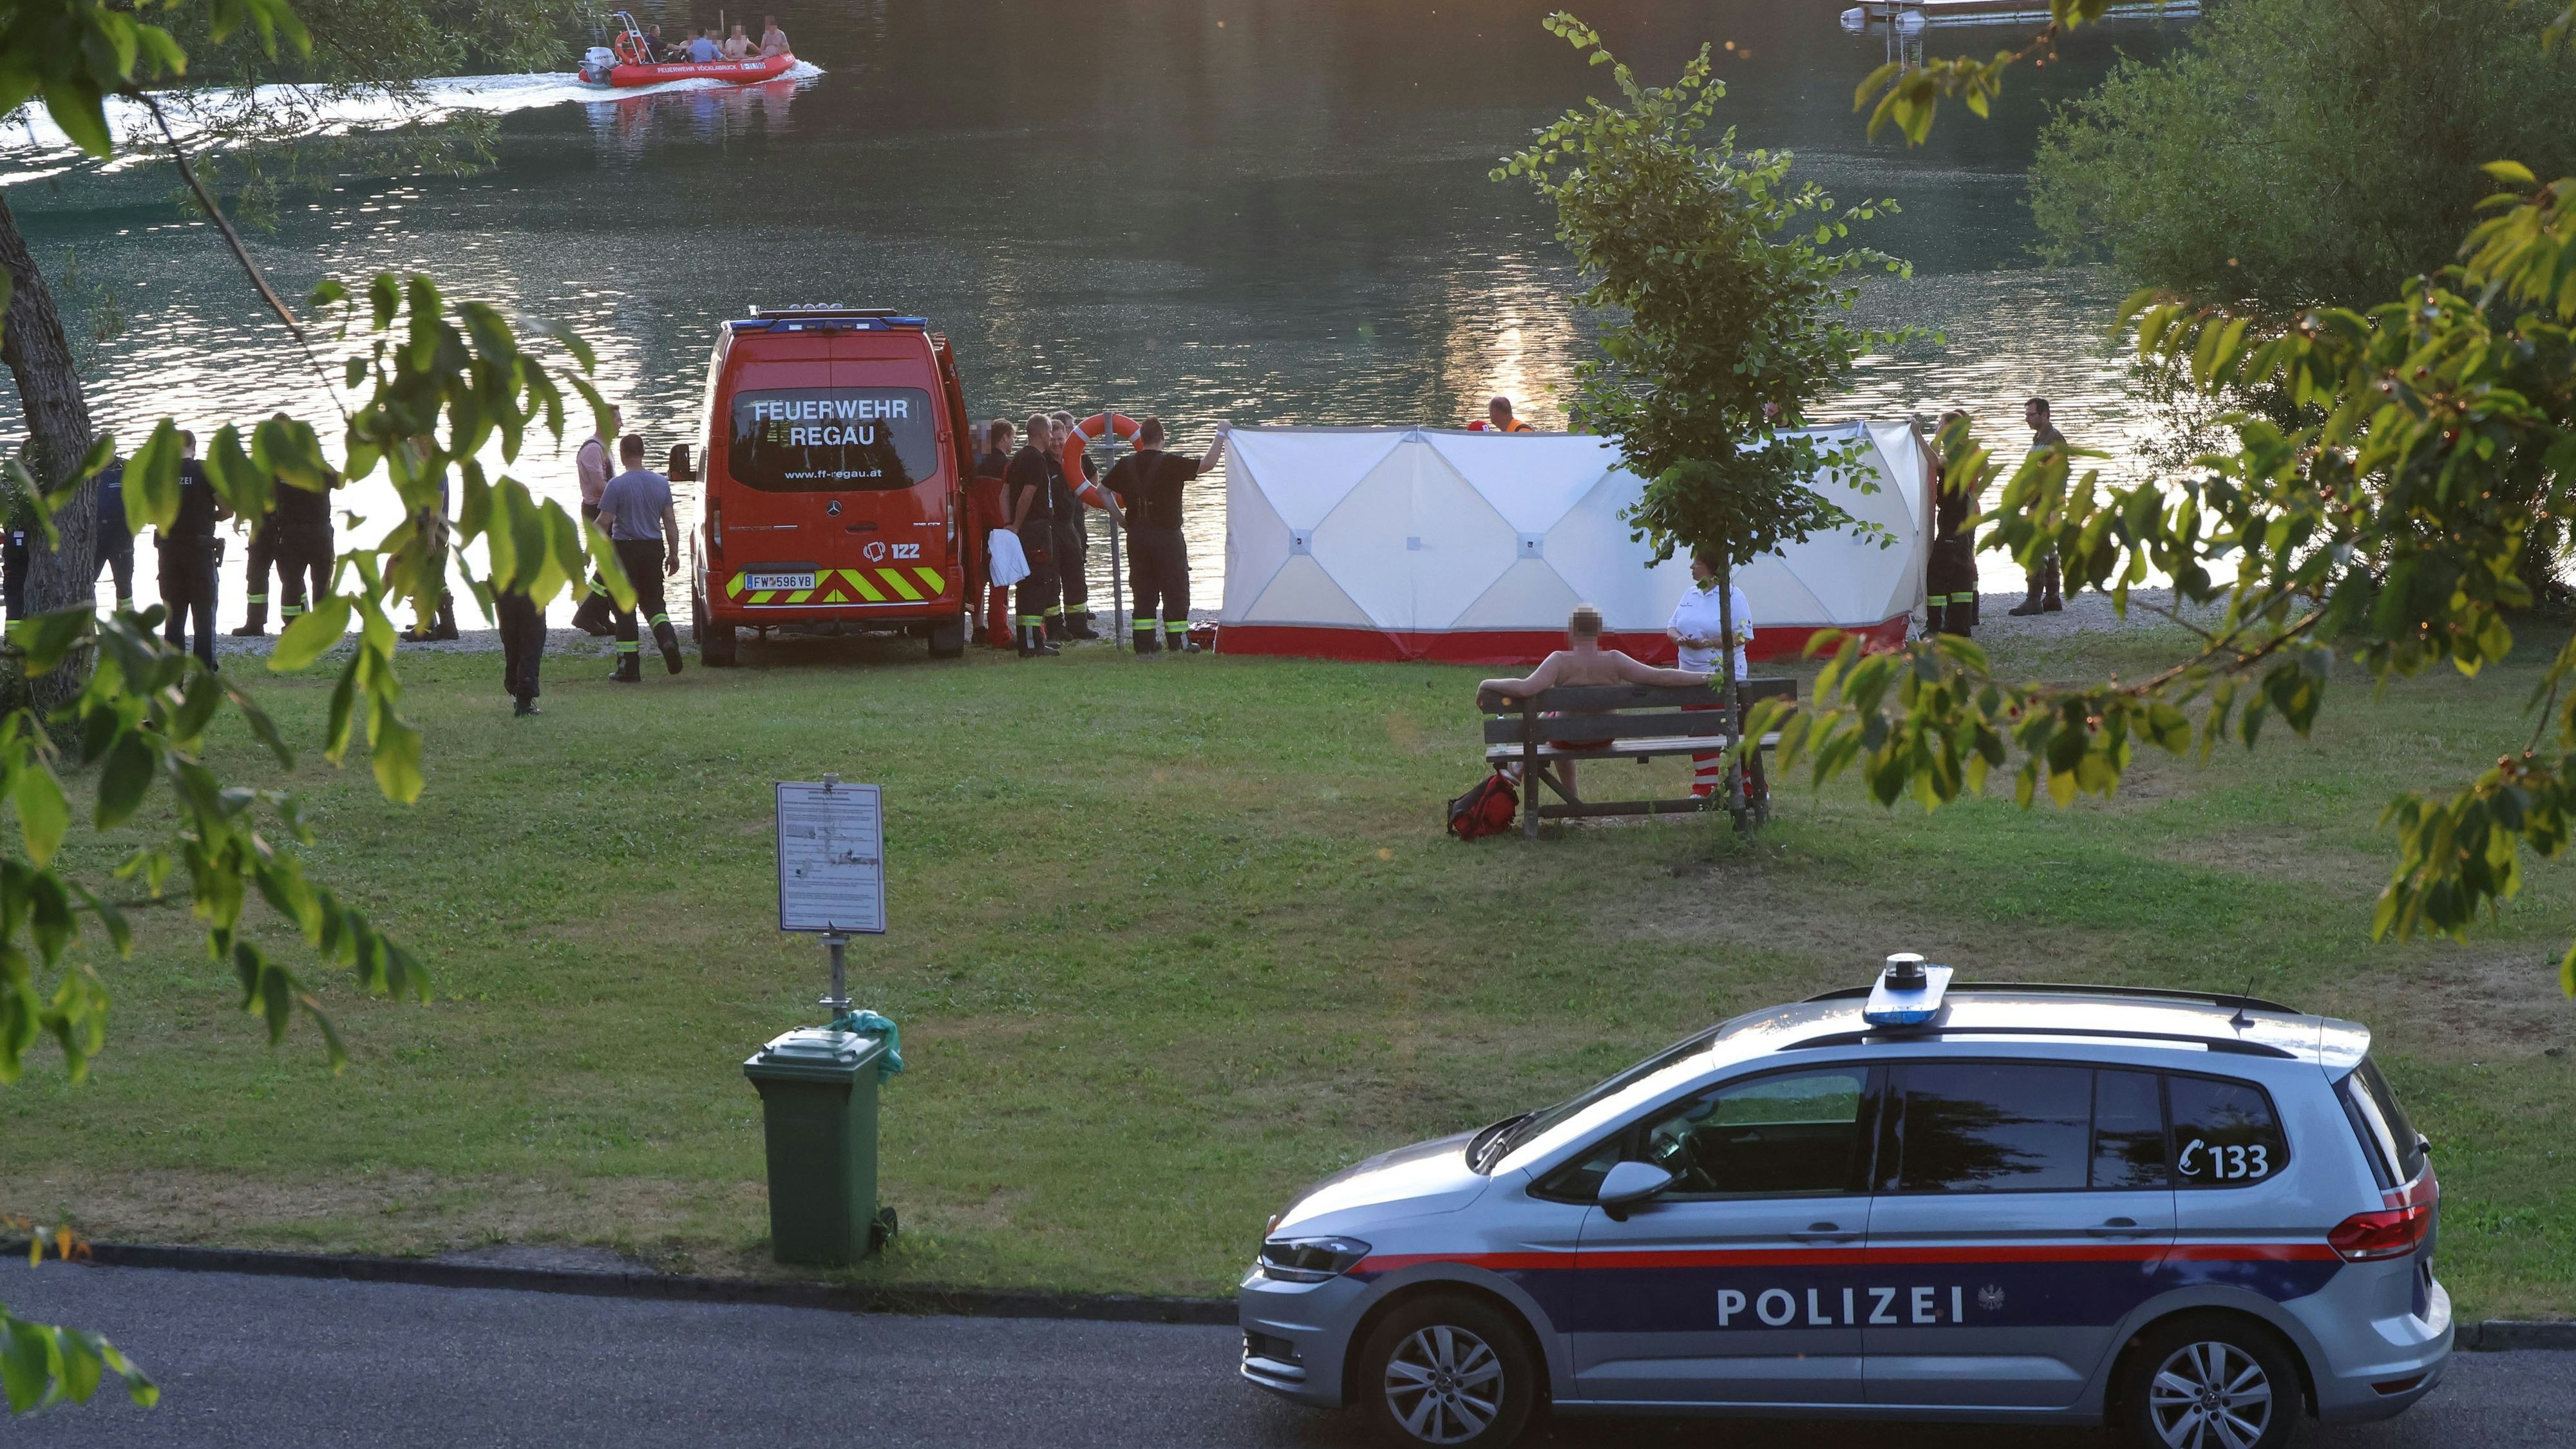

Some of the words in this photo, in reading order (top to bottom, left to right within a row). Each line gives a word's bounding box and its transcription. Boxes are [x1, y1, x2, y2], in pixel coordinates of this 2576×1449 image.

[755, 400, 907, 421] FEUERWEHR
[790, 426, 874, 446] REGAU
[785, 469, 882, 479] www.ff-regau.at
[891, 544, 920, 559] 122
[754, 577, 768, 587] FW
[777, 576, 796, 587] 596
[799, 576, 811, 586] VB
[2208, 1144, 2268, 1178] 133
[1718, 1286, 1962, 1326] POLIZEI
